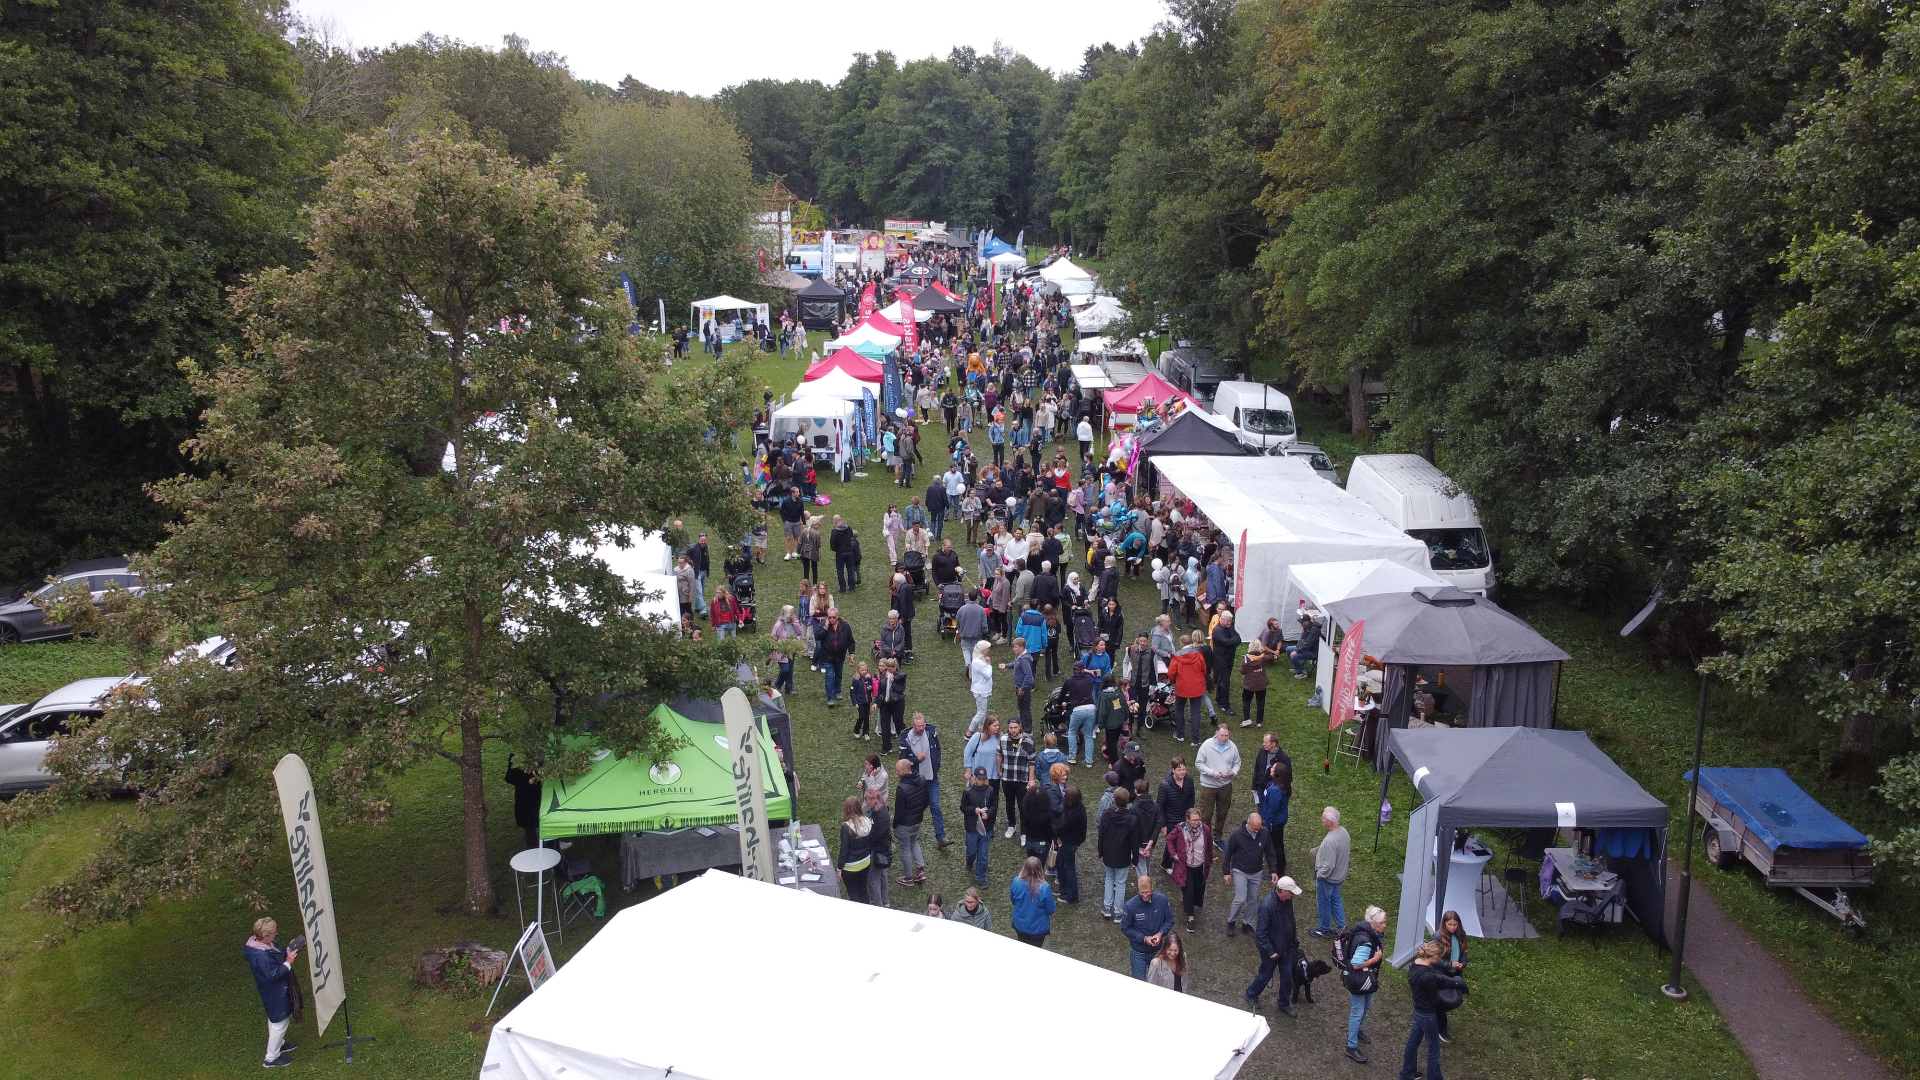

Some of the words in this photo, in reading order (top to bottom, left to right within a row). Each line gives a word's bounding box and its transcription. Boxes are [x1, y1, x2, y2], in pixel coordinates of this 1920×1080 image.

[639, 786, 695, 797] HERBALIFE
[577, 822, 606, 834] MAXIMIZE
[607, 821, 623, 833] YOUR
[624, 819, 655, 832] NUTRITION
[680, 816, 709, 828] MAXIMIZE
[709, 814, 725, 826] YOUR
